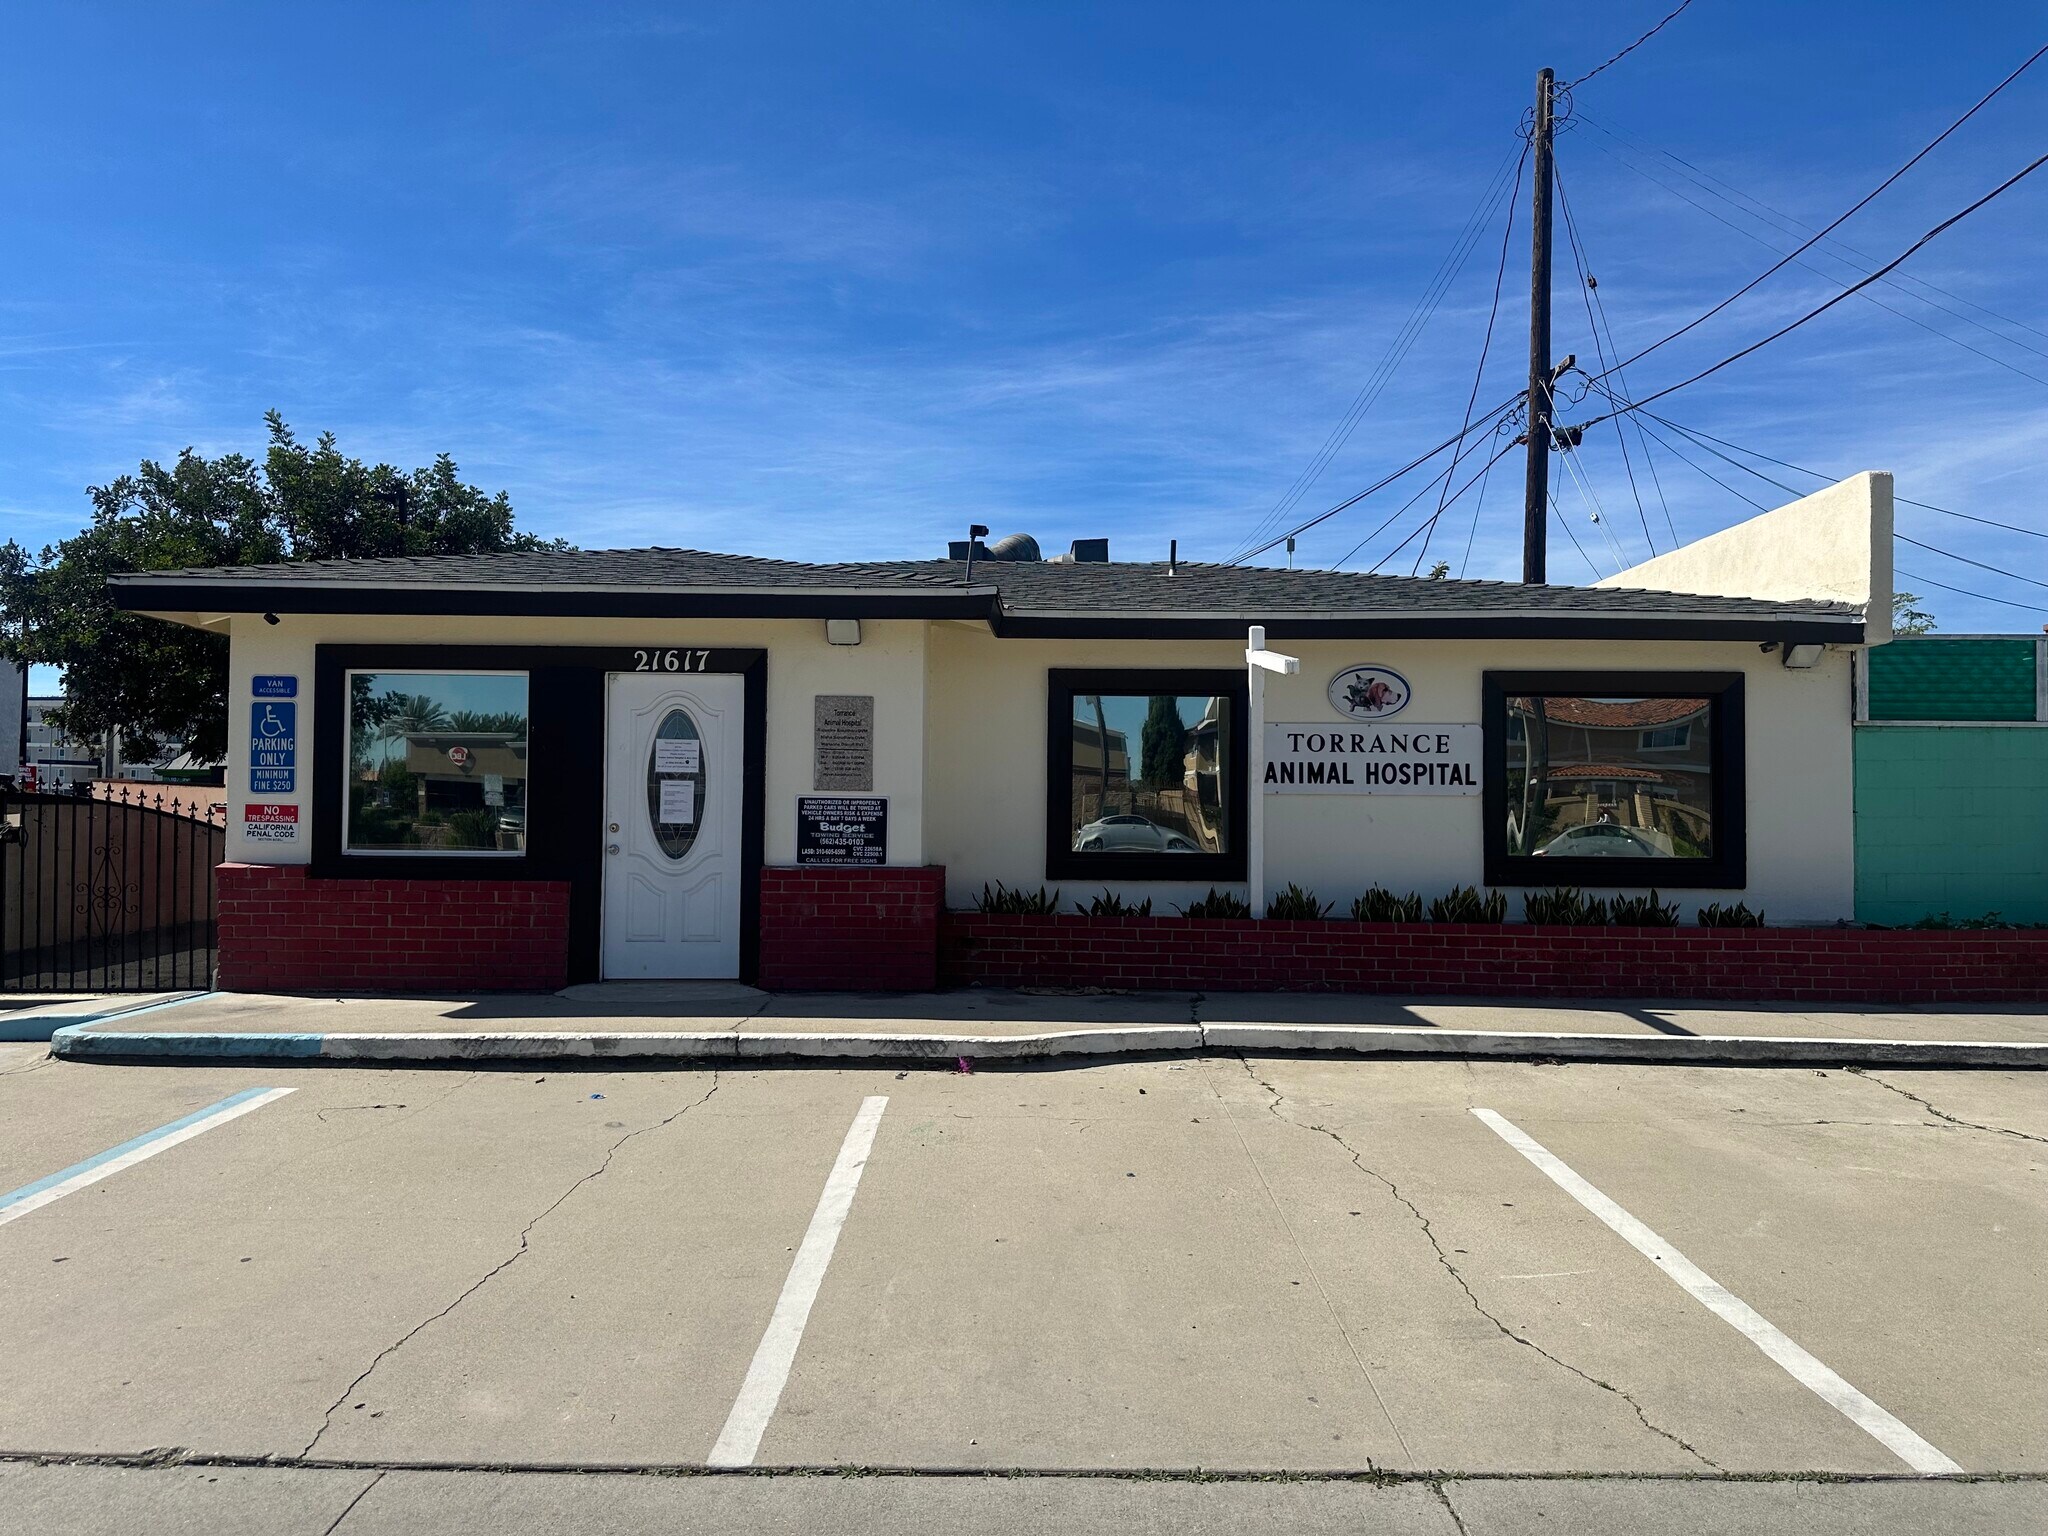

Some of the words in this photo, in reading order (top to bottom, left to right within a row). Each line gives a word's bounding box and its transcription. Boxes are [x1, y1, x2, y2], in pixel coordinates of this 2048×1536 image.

[634, 650, 710, 671] 21617
[252, 738, 293, 750] PARKING
[1287, 733, 1450, 754] TORRANCE
[260, 753, 286, 765] ONLY
[257, 770, 288, 779] MINIMUM
[1264, 761, 1354, 785] ANIMAL
[1366, 762, 1477, 786] HOSPITAL
[254, 781, 270, 789] FINE
[273, 780, 290, 790] $250
[264, 806, 280, 815] NO
[820, 822, 865, 833] Budget
